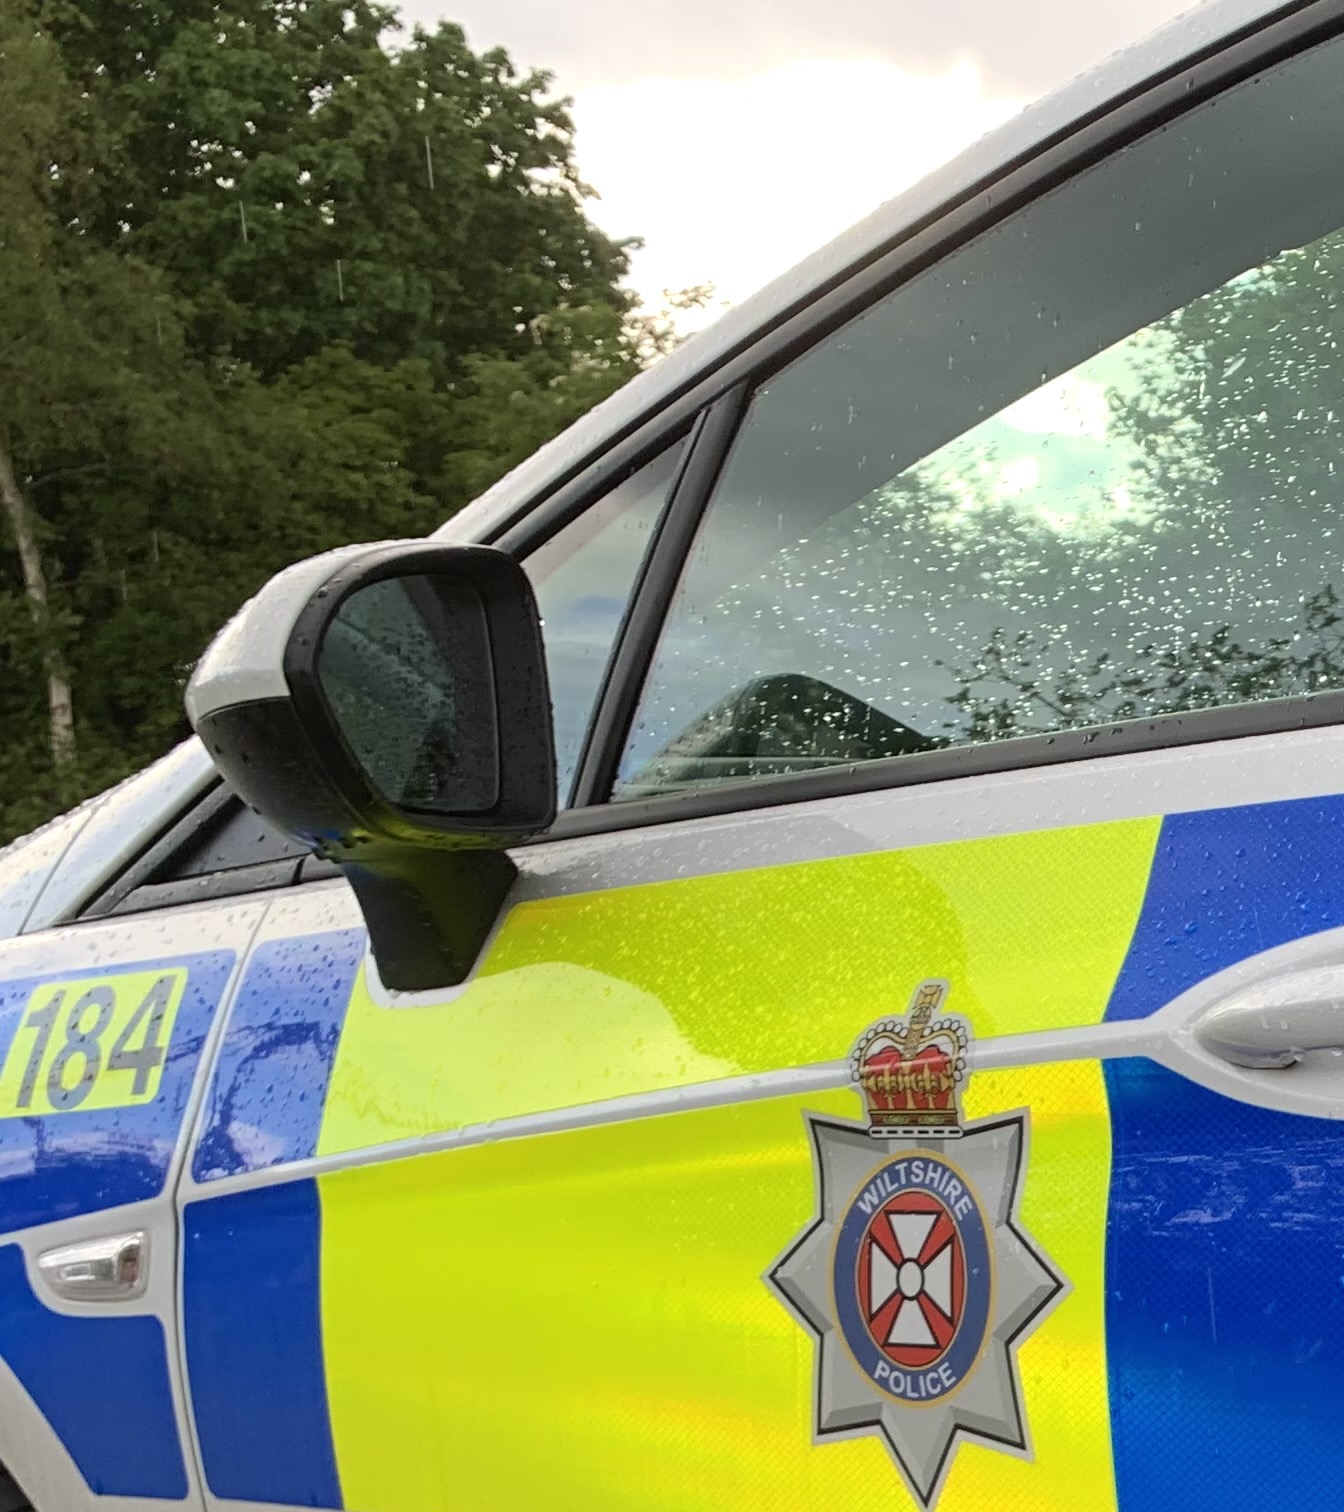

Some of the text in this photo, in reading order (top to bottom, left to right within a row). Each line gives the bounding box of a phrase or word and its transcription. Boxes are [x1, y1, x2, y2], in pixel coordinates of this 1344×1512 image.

[16, 974, 177, 1110] 184
[855, 1160, 973, 1222] WILTSHIRE
[873, 1359, 958, 1399] POLICE
